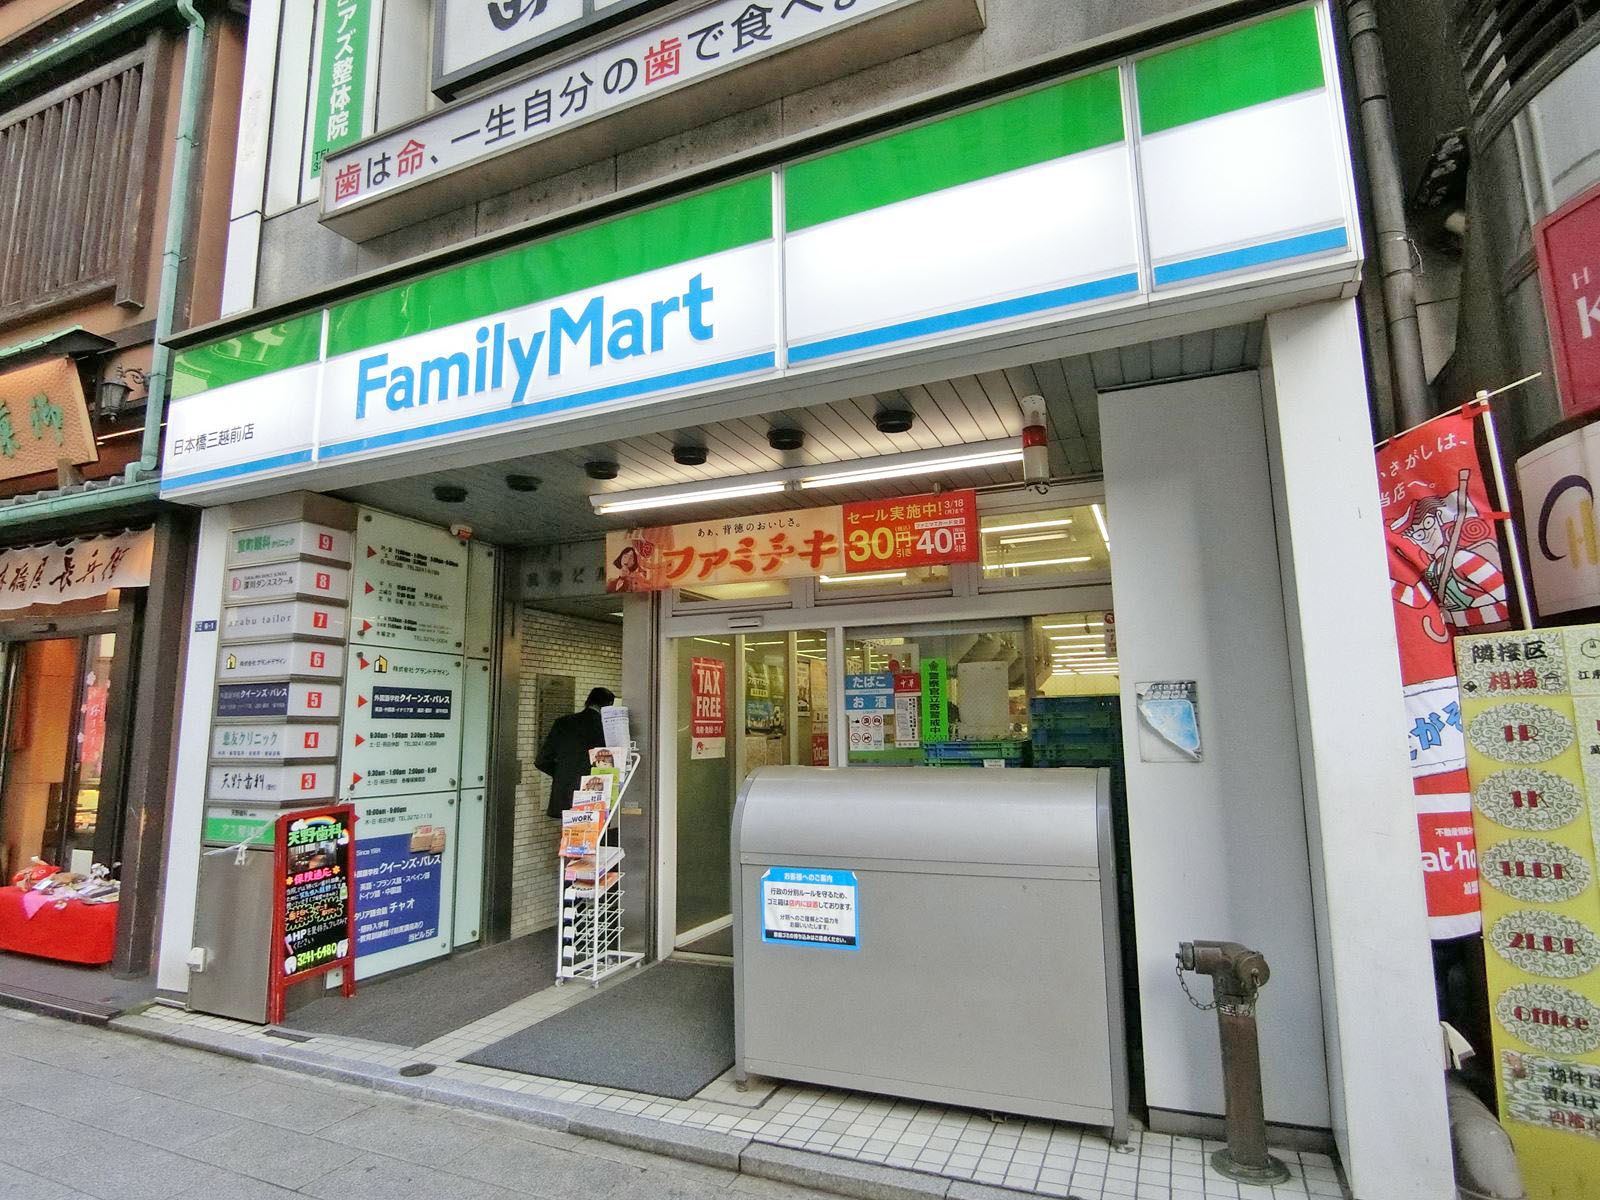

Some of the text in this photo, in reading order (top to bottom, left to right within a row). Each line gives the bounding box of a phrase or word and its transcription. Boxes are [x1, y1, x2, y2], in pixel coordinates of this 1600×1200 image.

[355, 271, 715, 407] FamilyMart
[173, 423, 255, 456] 日本橋三越前店
[1380, 432, 1467, 477] さがしは、
[944, 498, 964, 509] 3/18
[322, 535, 330, 549] 9
[849, 527, 894, 561] 30
[916, 528, 953, 554] 40
[662, 530, 839, 581] ファミチキ
[319, 575, 328, 588] 8
[262, 613, 292, 625] tailor
[313, 653, 322, 667] 6
[697, 669, 721, 696] TAX
[853, 676, 887, 689] たばこ
[1487, 667, 1539, 691] 相場
[311, 693, 319, 707] 5
[696, 696, 722, 718] FREE
[852, 696, 887, 709] お酒
[308, 733, 316, 747] 4
[220, 772, 265, 791] 天野歯科
[304, 774, 313, 788] 3
[571, 814, 594, 824] WORK
[287, 822, 342, 848] 天野歯科
[1420, 847, 1454, 873] at
[783, 872, 833, 883] お客様へのご案内
[1500, 860, 1576, 881] 1LDK
[770, 887, 848, 900] 行政の分別ルールを守るため、
[389, 897, 416, 914] チャオ
[767, 898, 853, 912] ゴミ箱は店内に設置しております。
[1503, 931, 1587, 958] 2LDK
